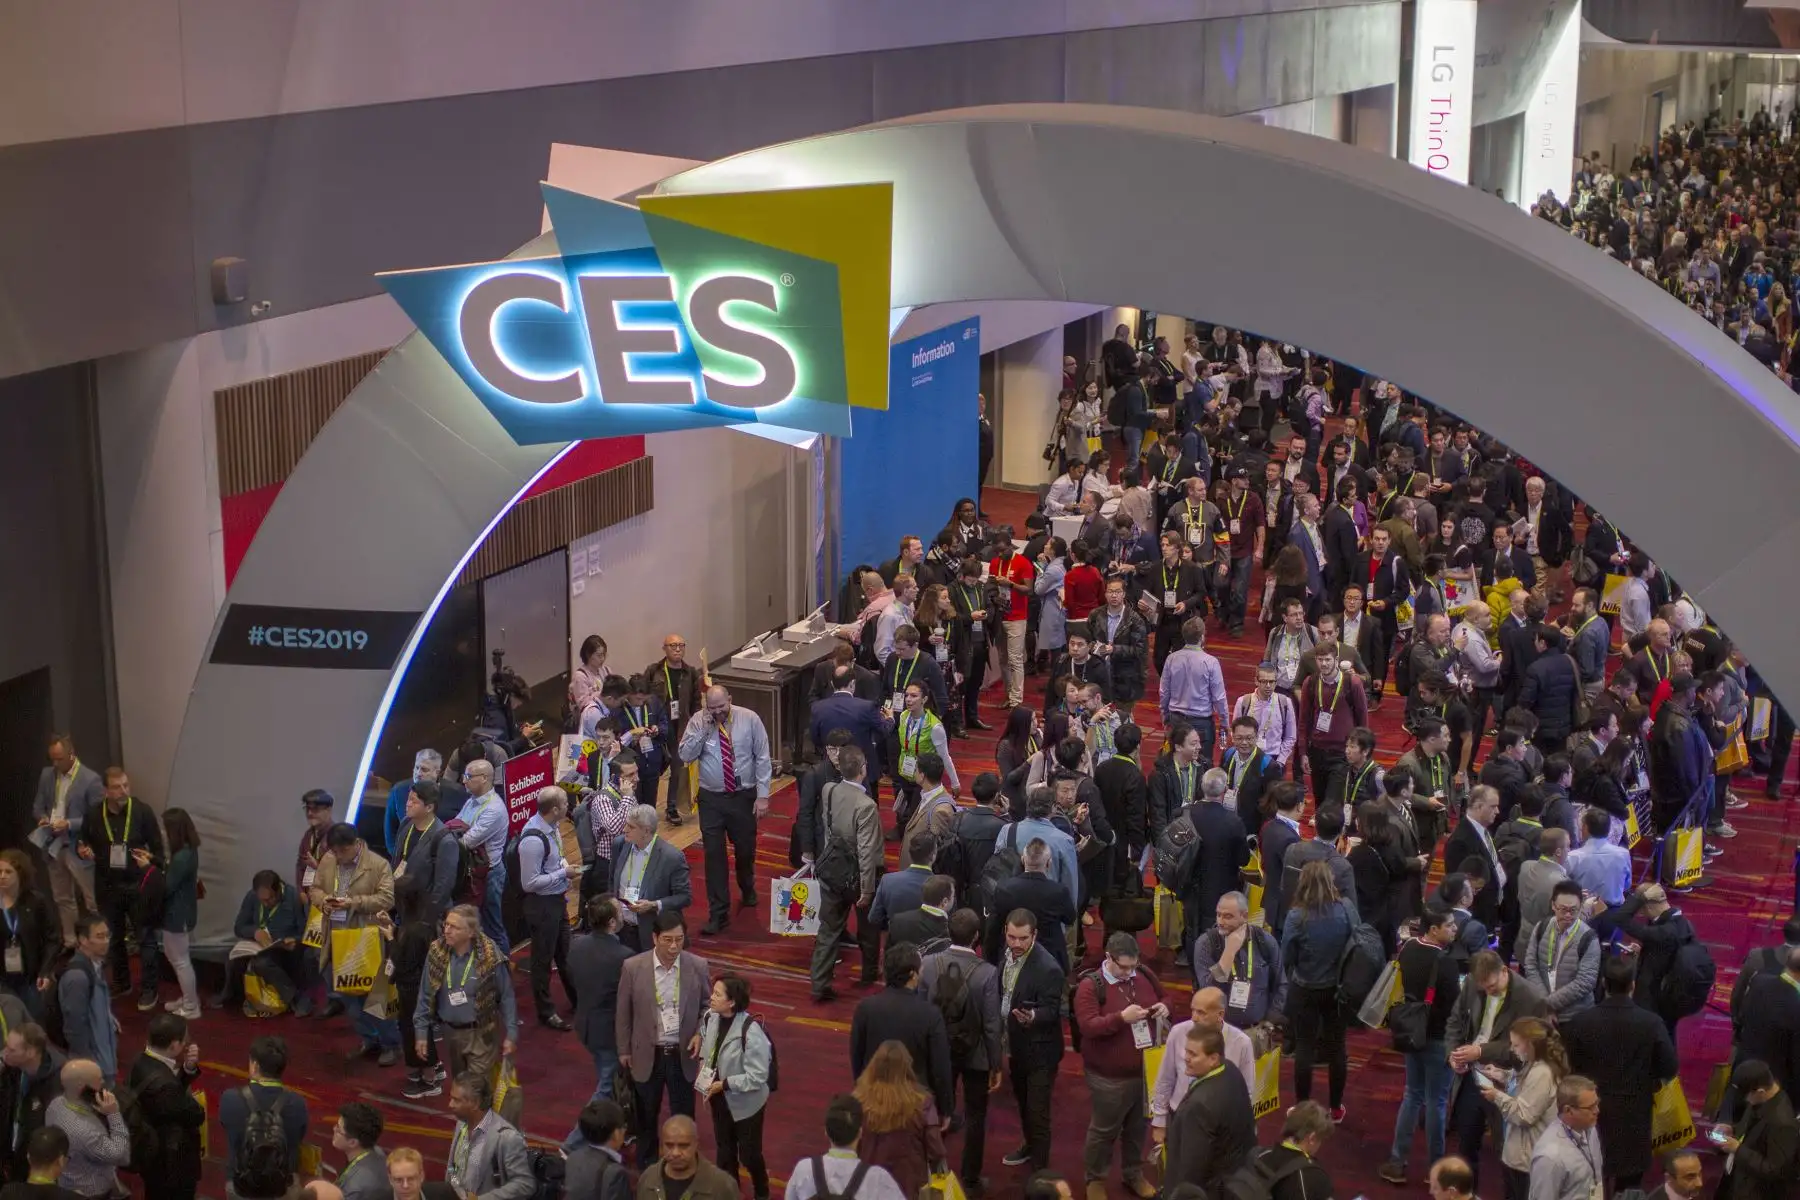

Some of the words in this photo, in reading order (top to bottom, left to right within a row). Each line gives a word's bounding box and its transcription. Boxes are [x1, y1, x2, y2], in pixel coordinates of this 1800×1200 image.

[1431, 46, 1455, 82] LG
[1427, 93, 1451, 173] ThinQ
[912, 340, 955, 368] Information
[248, 625, 368, 650] #CES2019
[510, 772, 545, 794] Exhibitor
[511, 788, 543, 808] Entranc
[512, 807, 530, 823] Only
[336, 975, 375, 988] Niko
[1253, 1096, 1278, 1117] ikon
